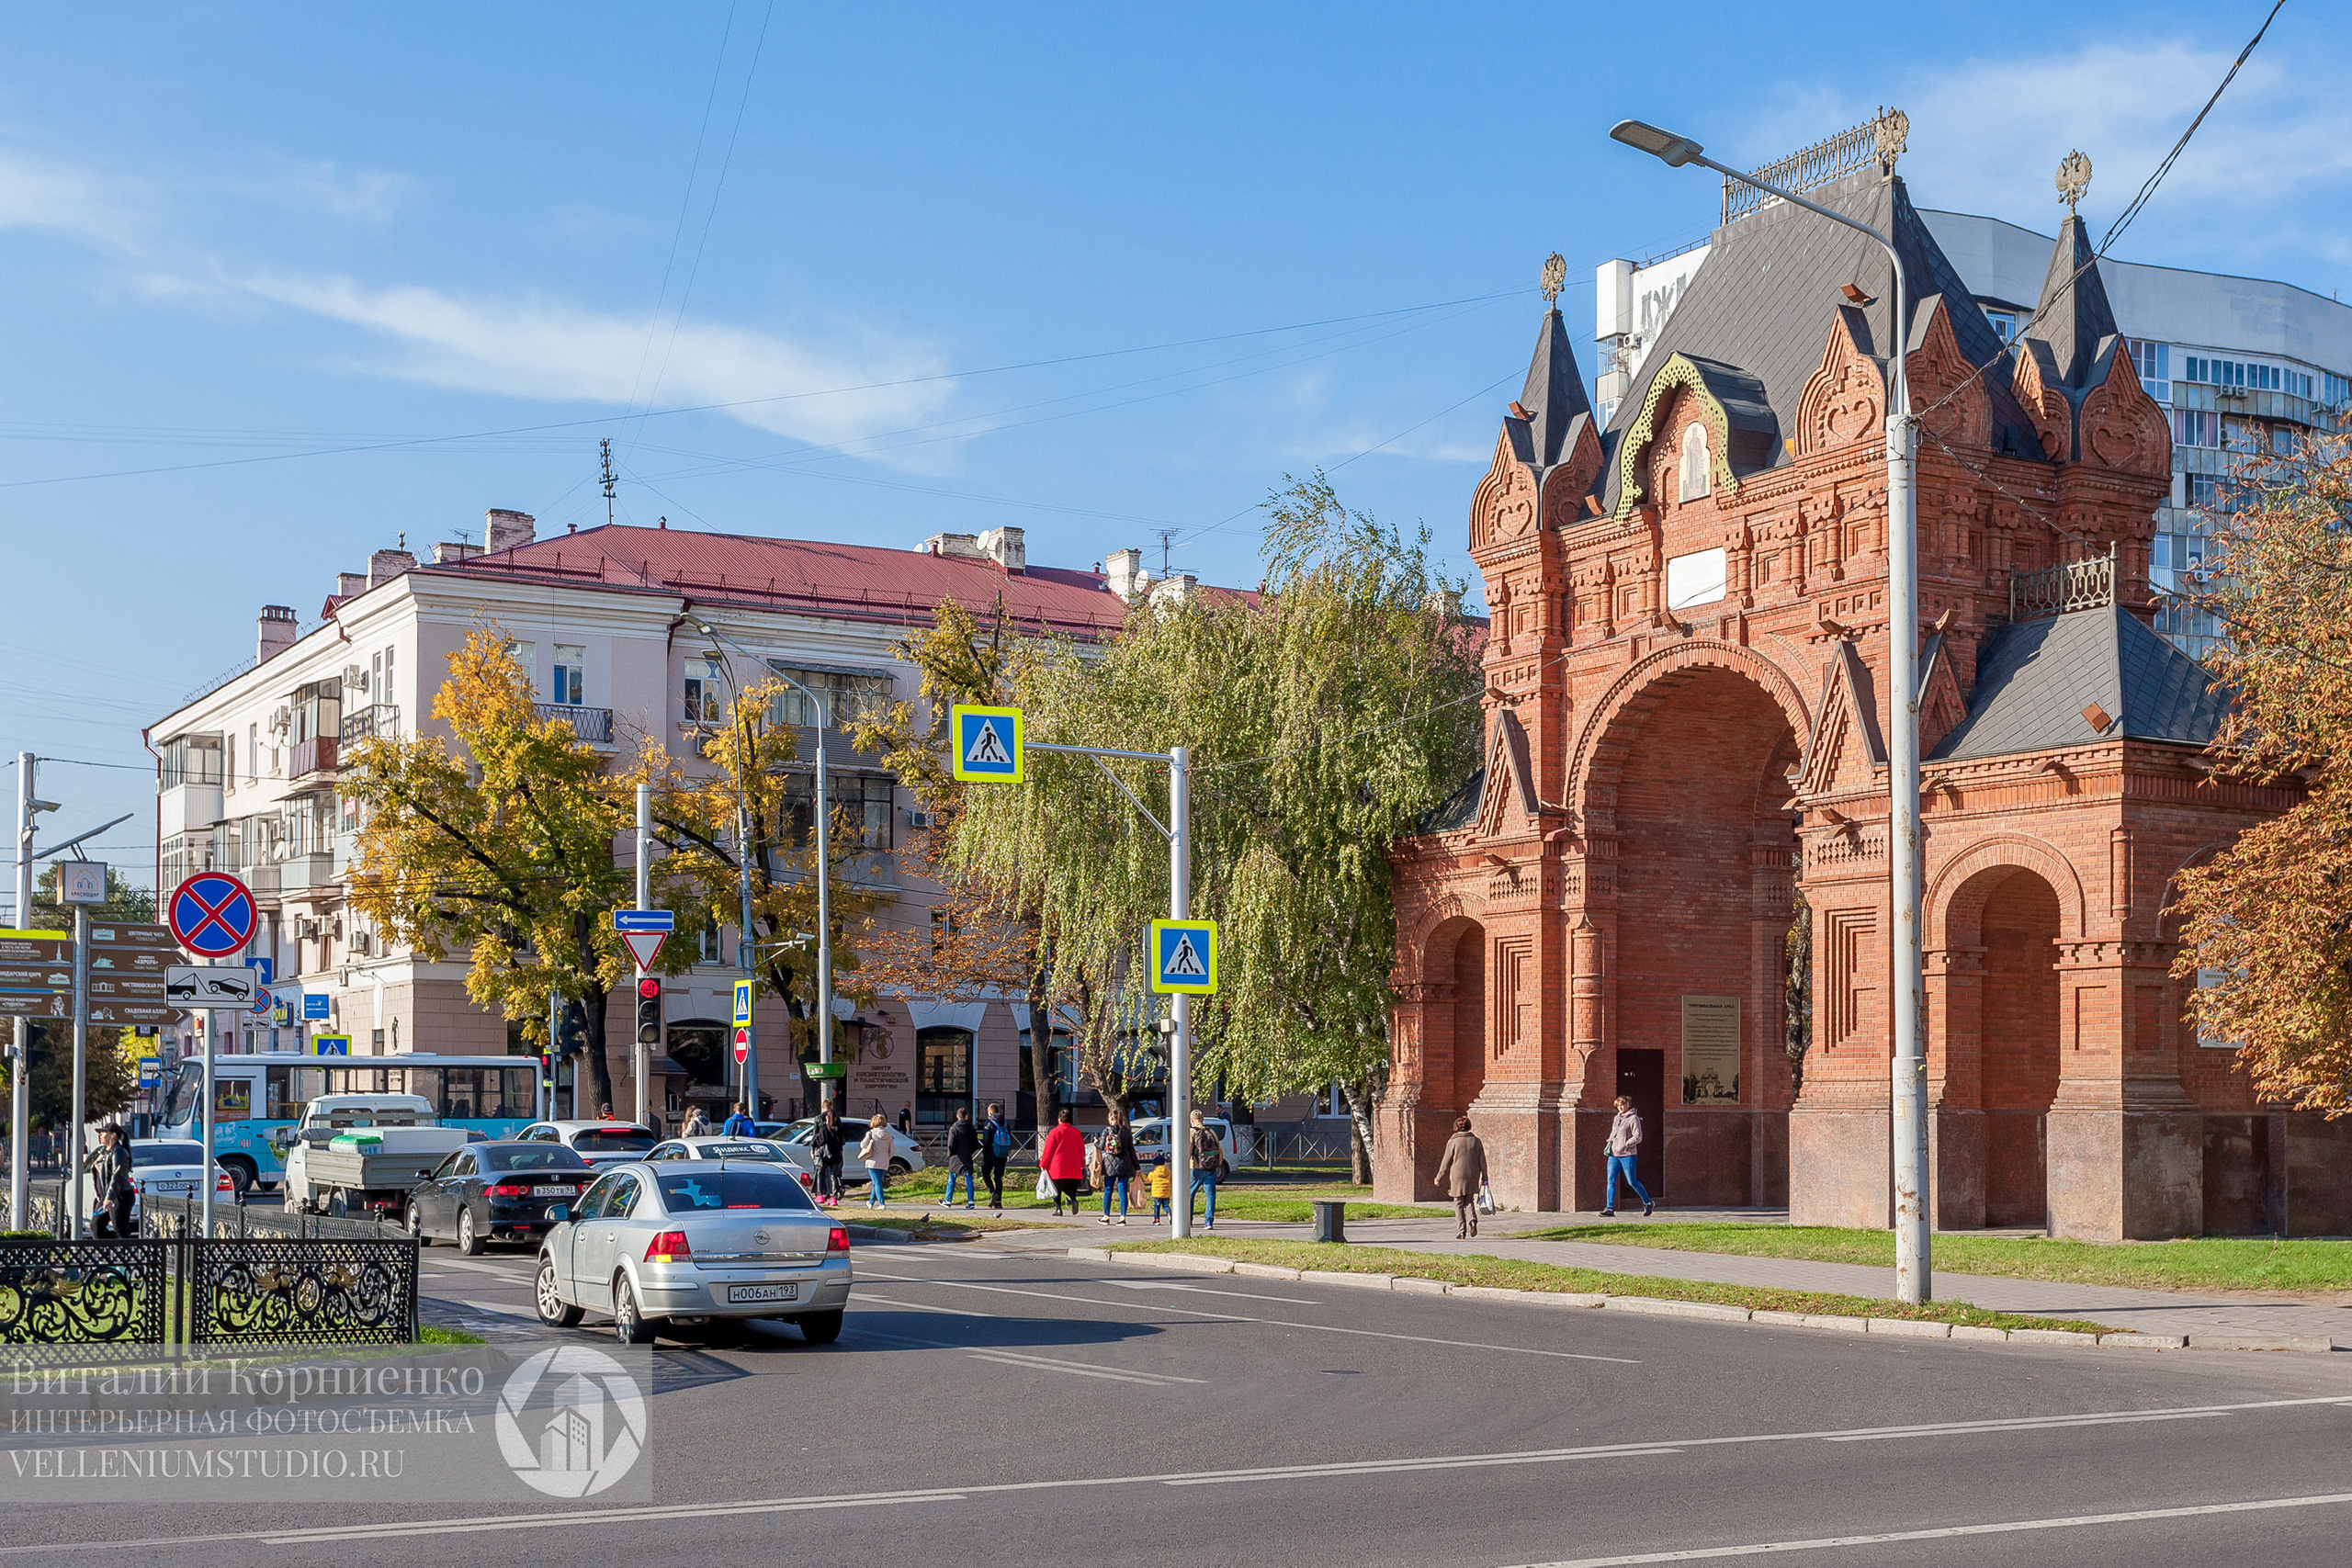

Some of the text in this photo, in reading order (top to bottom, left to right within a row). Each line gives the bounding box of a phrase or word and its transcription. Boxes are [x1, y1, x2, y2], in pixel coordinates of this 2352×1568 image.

[712, 1145, 751, 1154] Яндекс
[733, 1285, 795, 1300] Н006АН 193
